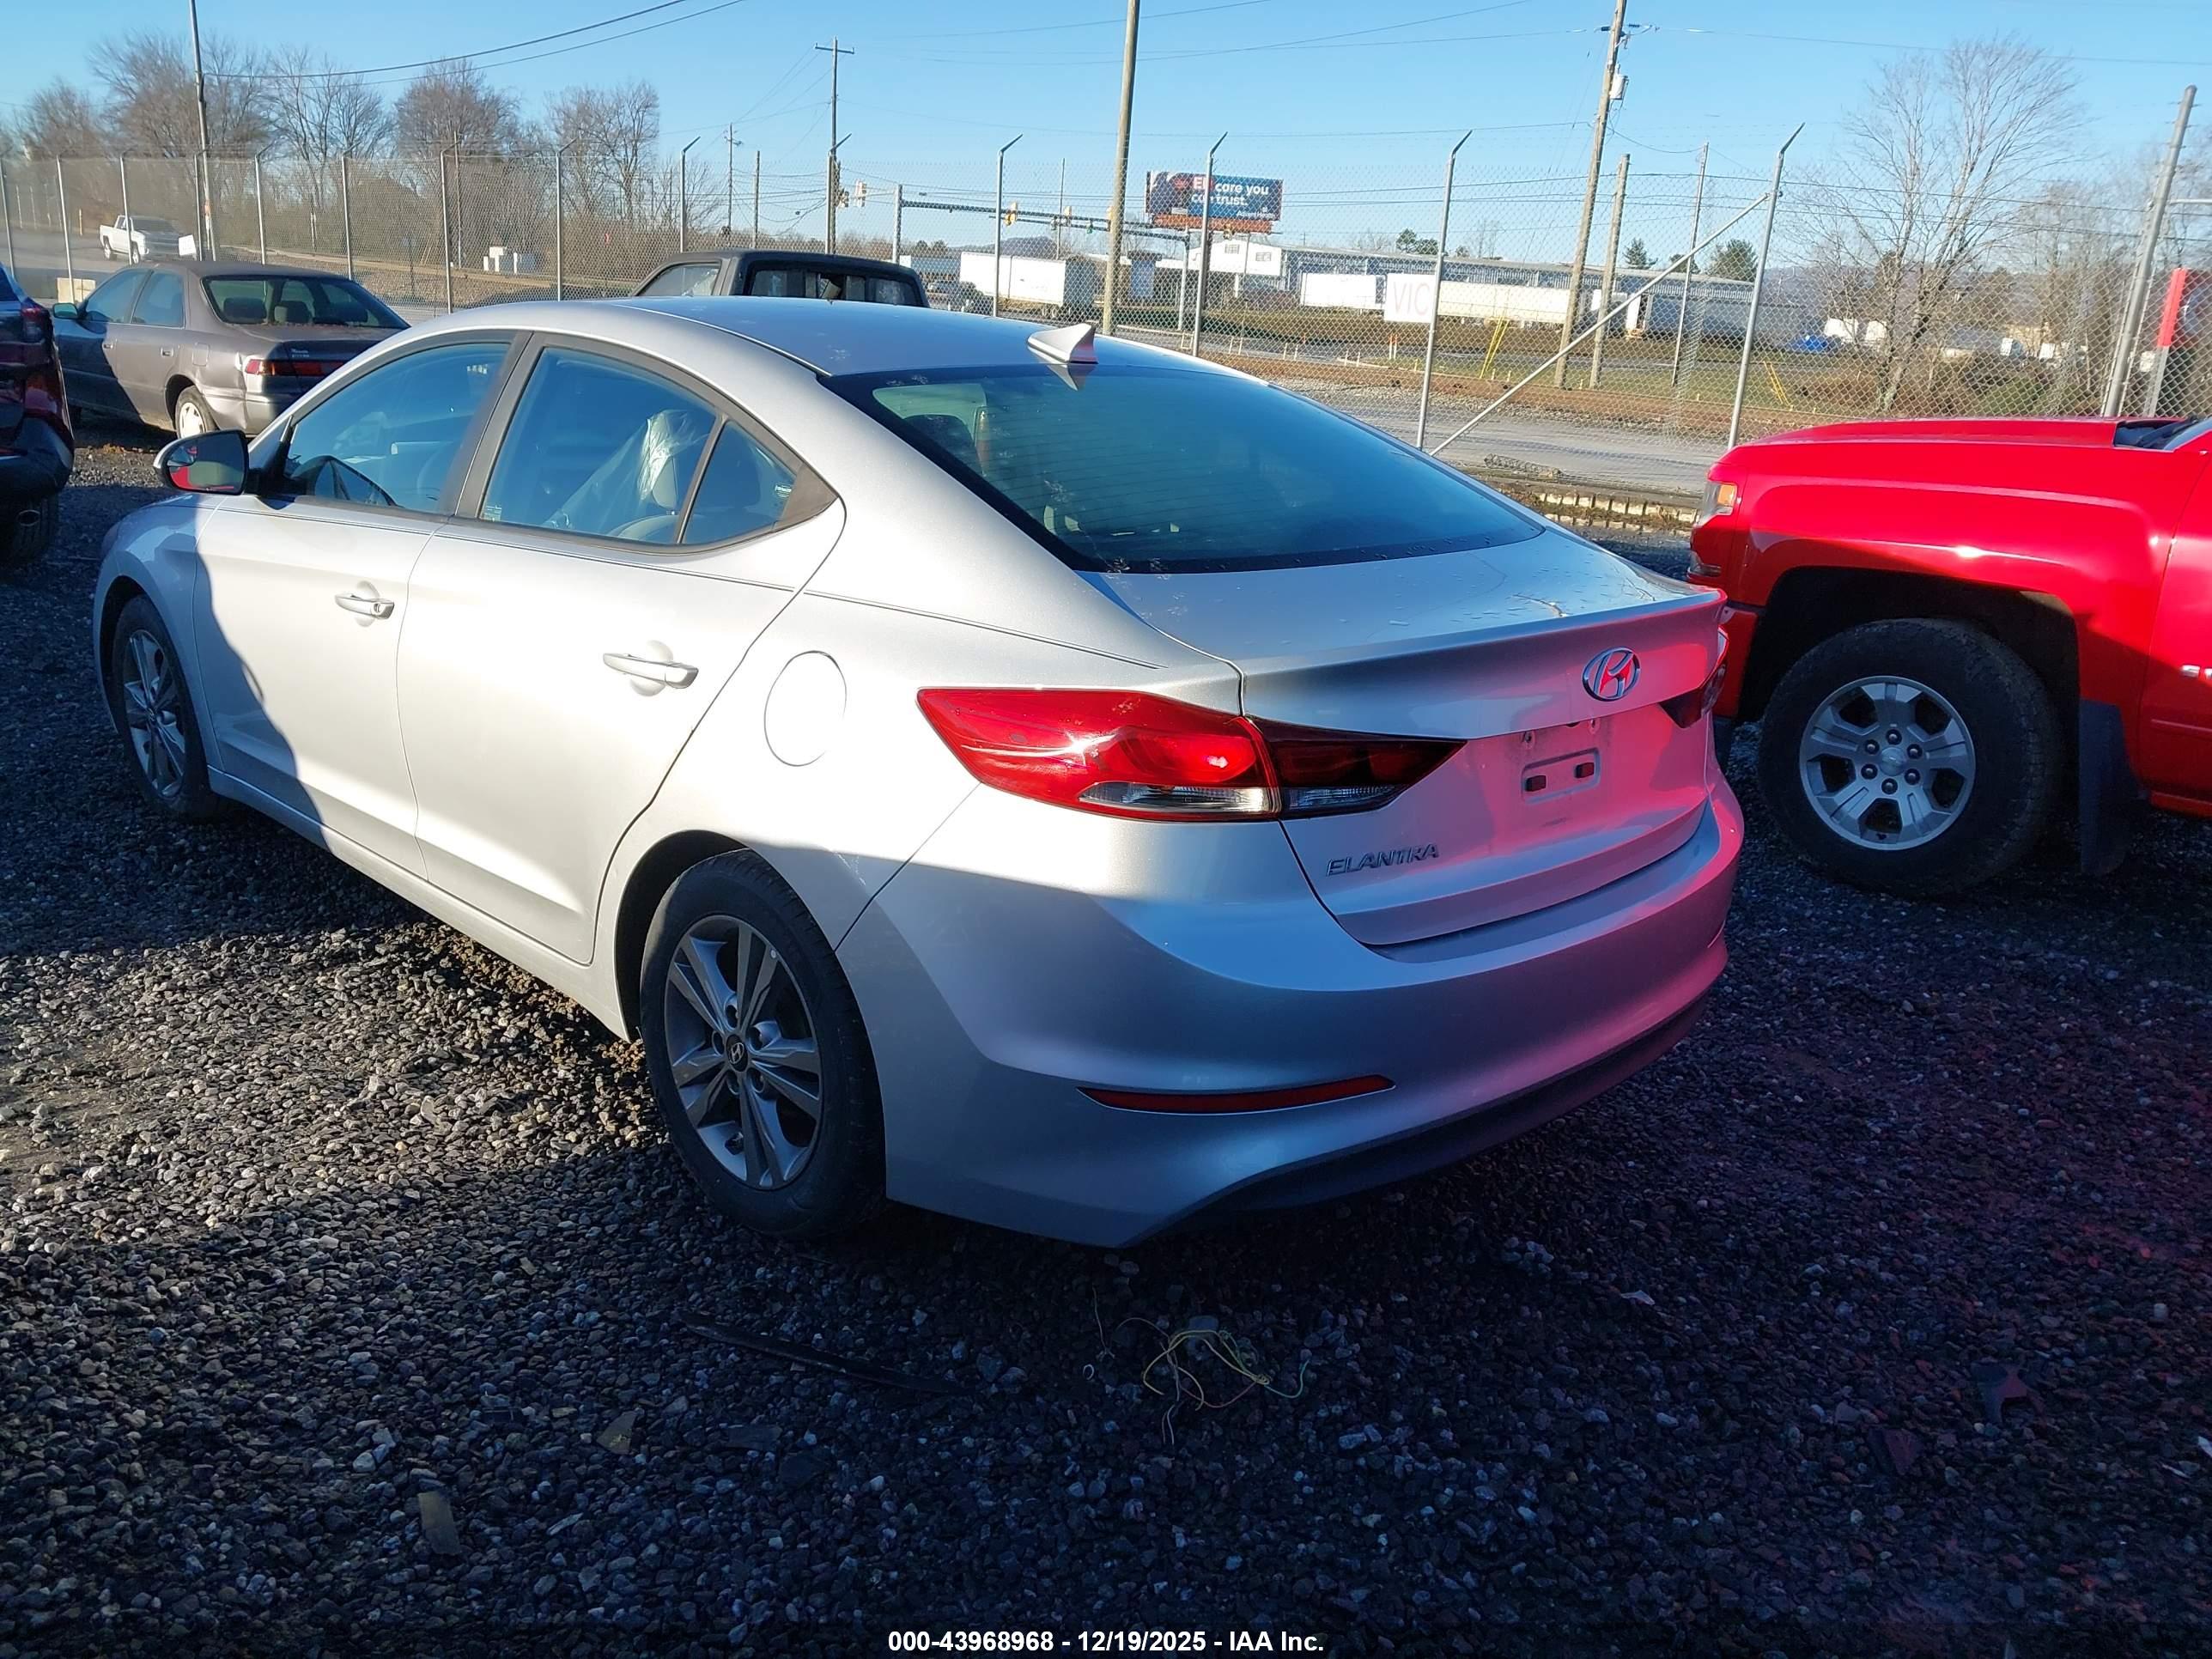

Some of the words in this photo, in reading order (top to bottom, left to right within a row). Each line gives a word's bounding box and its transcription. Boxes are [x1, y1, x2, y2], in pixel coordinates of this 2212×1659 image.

[1215, 183, 1243, 193] care
[1246, 185, 1269, 196] you
[1216, 195, 1249, 206] trust.
[1327, 843, 1439, 876] ELANTRA
